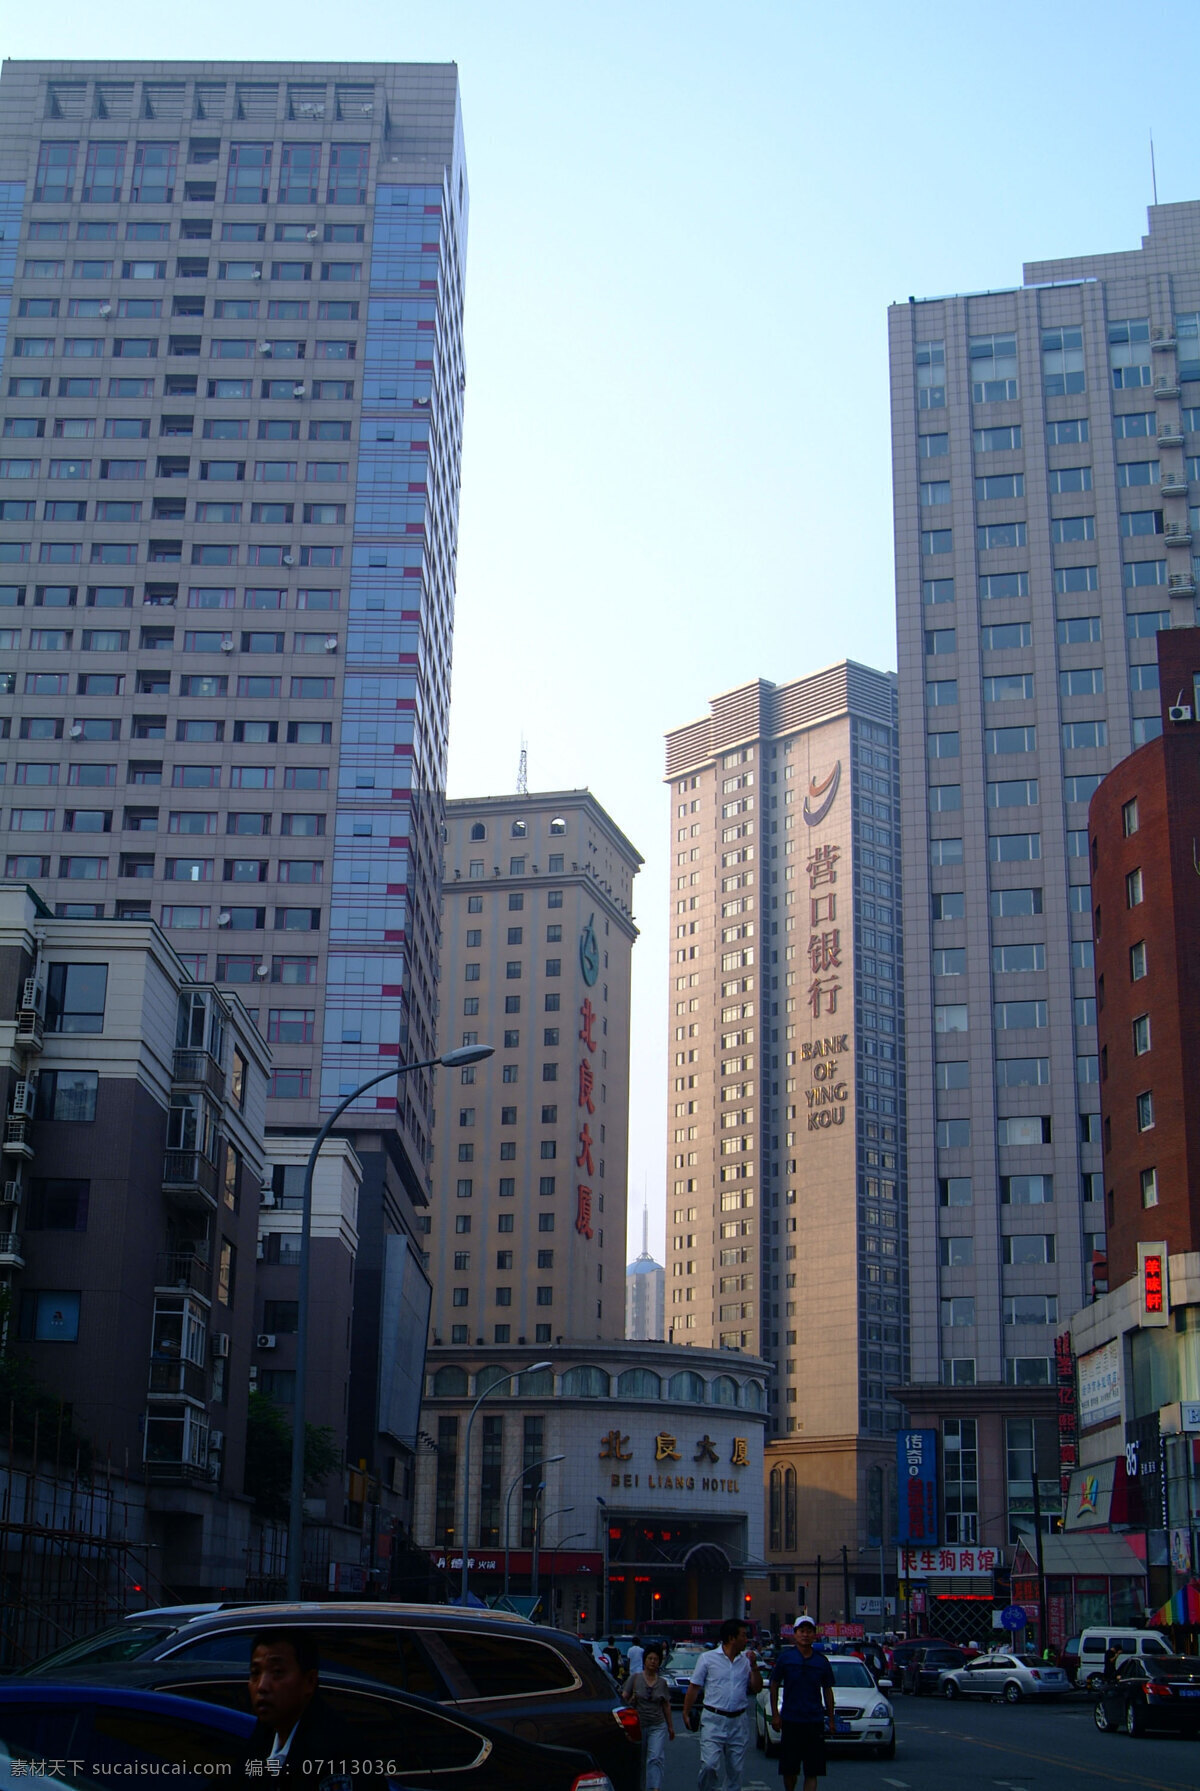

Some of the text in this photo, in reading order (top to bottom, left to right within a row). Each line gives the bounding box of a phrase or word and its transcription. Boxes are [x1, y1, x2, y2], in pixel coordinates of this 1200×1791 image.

[805, 844, 842, 1018] 营口银行
[801, 1034, 849, 1061] BANK
[813, 1060, 838, 1081] OF
[804, 1083, 848, 1108] YING
[576, 998, 596, 1240] 北良大厦
[807, 1105, 845, 1131] KOU
[599, 1430, 750, 1467] 北良大厦
[611, 1473, 740, 1493] BEI LIANG HOTEL
[901, 1550, 995, 1572] 民生狗肉馆
